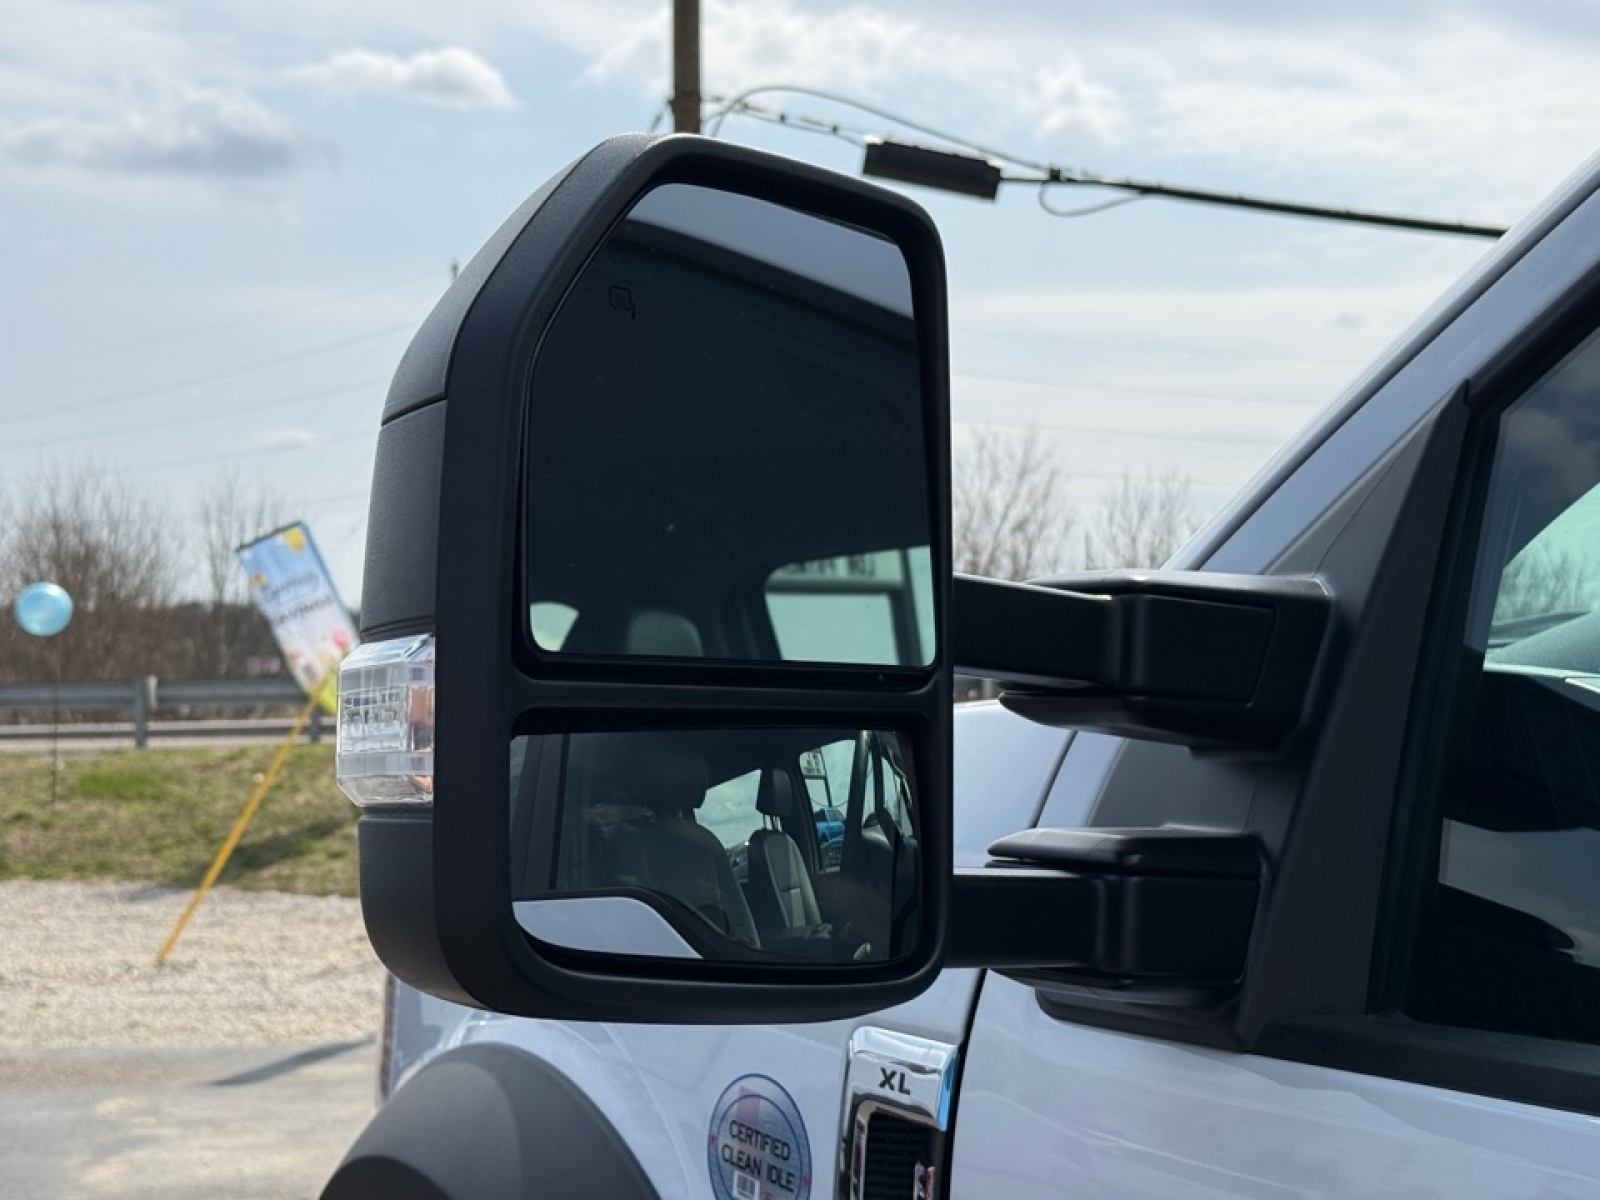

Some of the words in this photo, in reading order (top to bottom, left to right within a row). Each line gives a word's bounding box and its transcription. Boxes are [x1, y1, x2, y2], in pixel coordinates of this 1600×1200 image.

[878, 1066, 911, 1095] XL
[729, 1119, 791, 1162] CERTIFIED
[721, 1143, 762, 1177] CLEAN
[766, 1162, 796, 1193] IDLE
